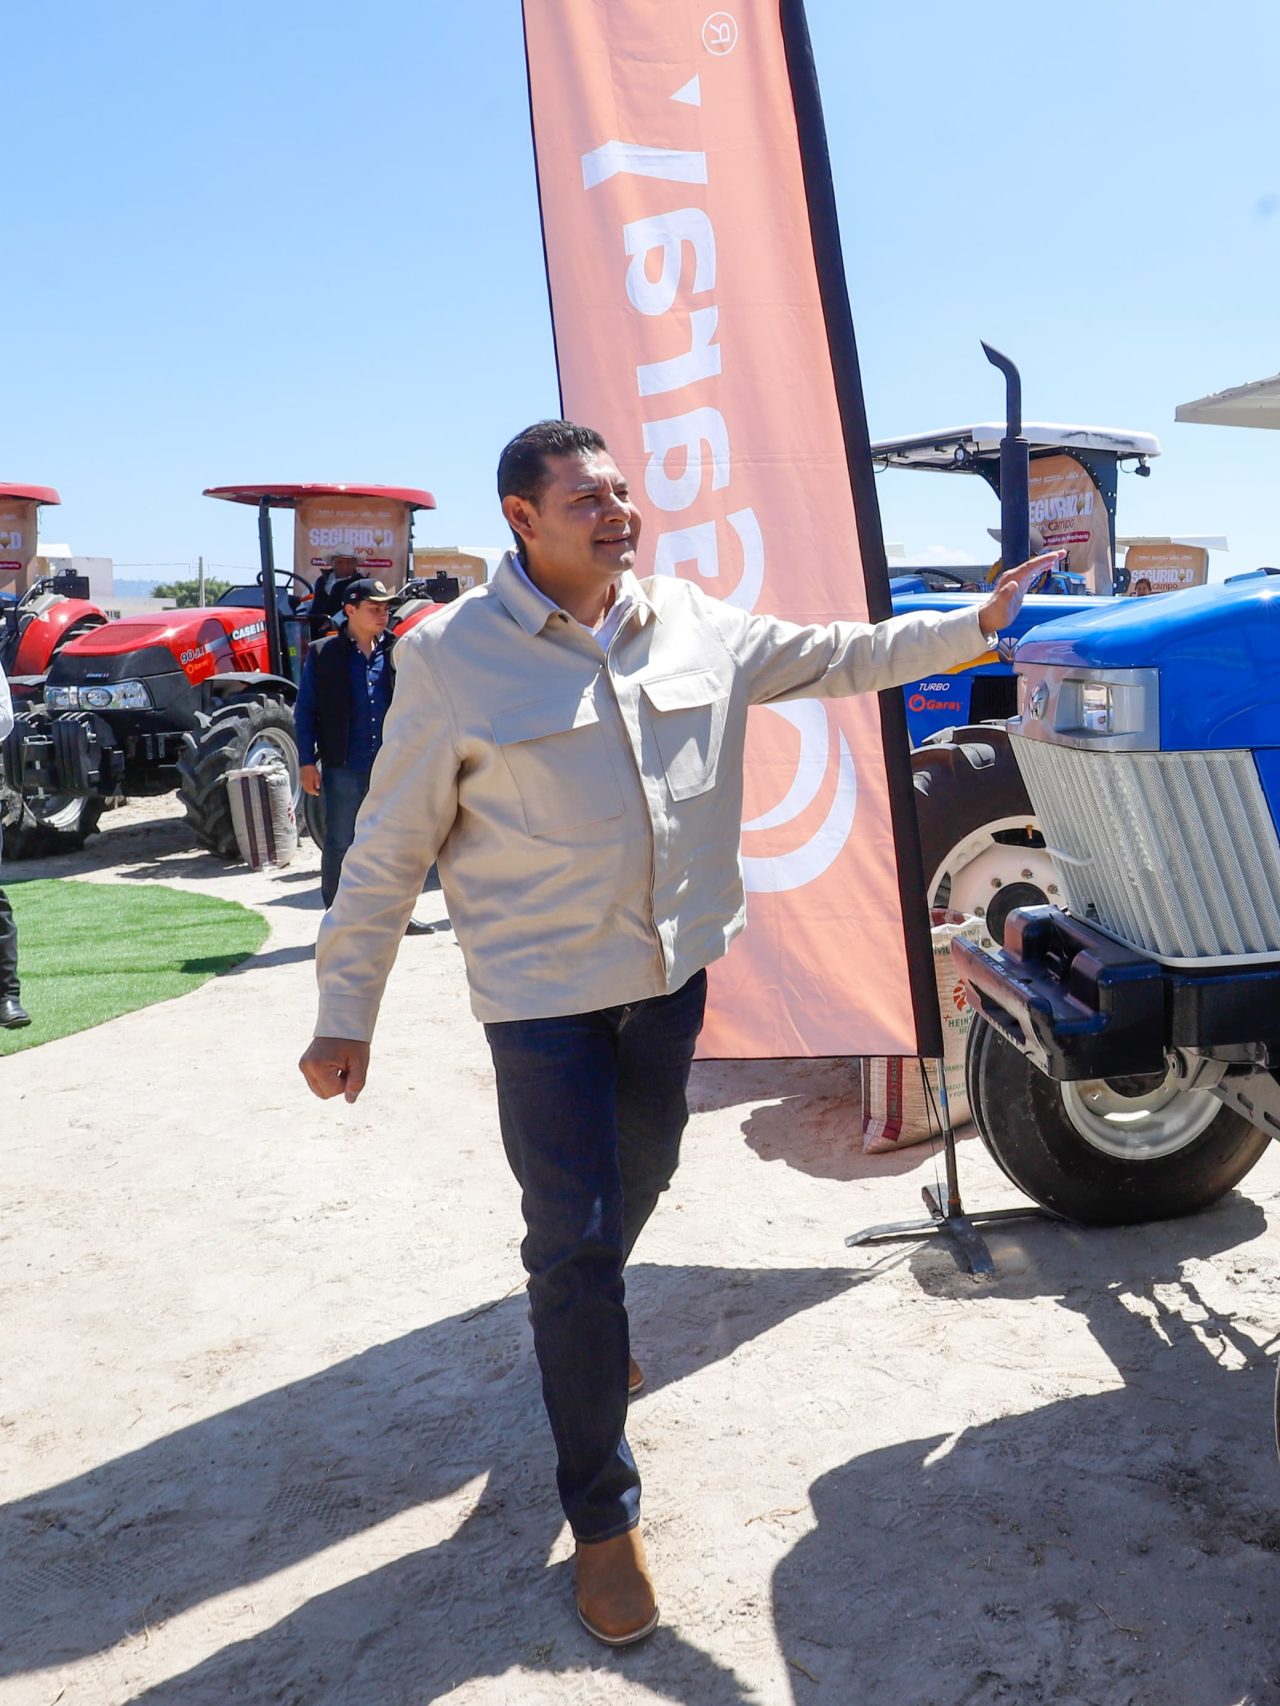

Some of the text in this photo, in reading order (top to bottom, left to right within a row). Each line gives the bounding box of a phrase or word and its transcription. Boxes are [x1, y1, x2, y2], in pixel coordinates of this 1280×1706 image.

[1028, 491, 1094, 523] EGURIDAD
[1048, 518, 1075, 531] campo
[232, 624, 256, 640] CASE
[918, 683, 950, 691] TURBO
